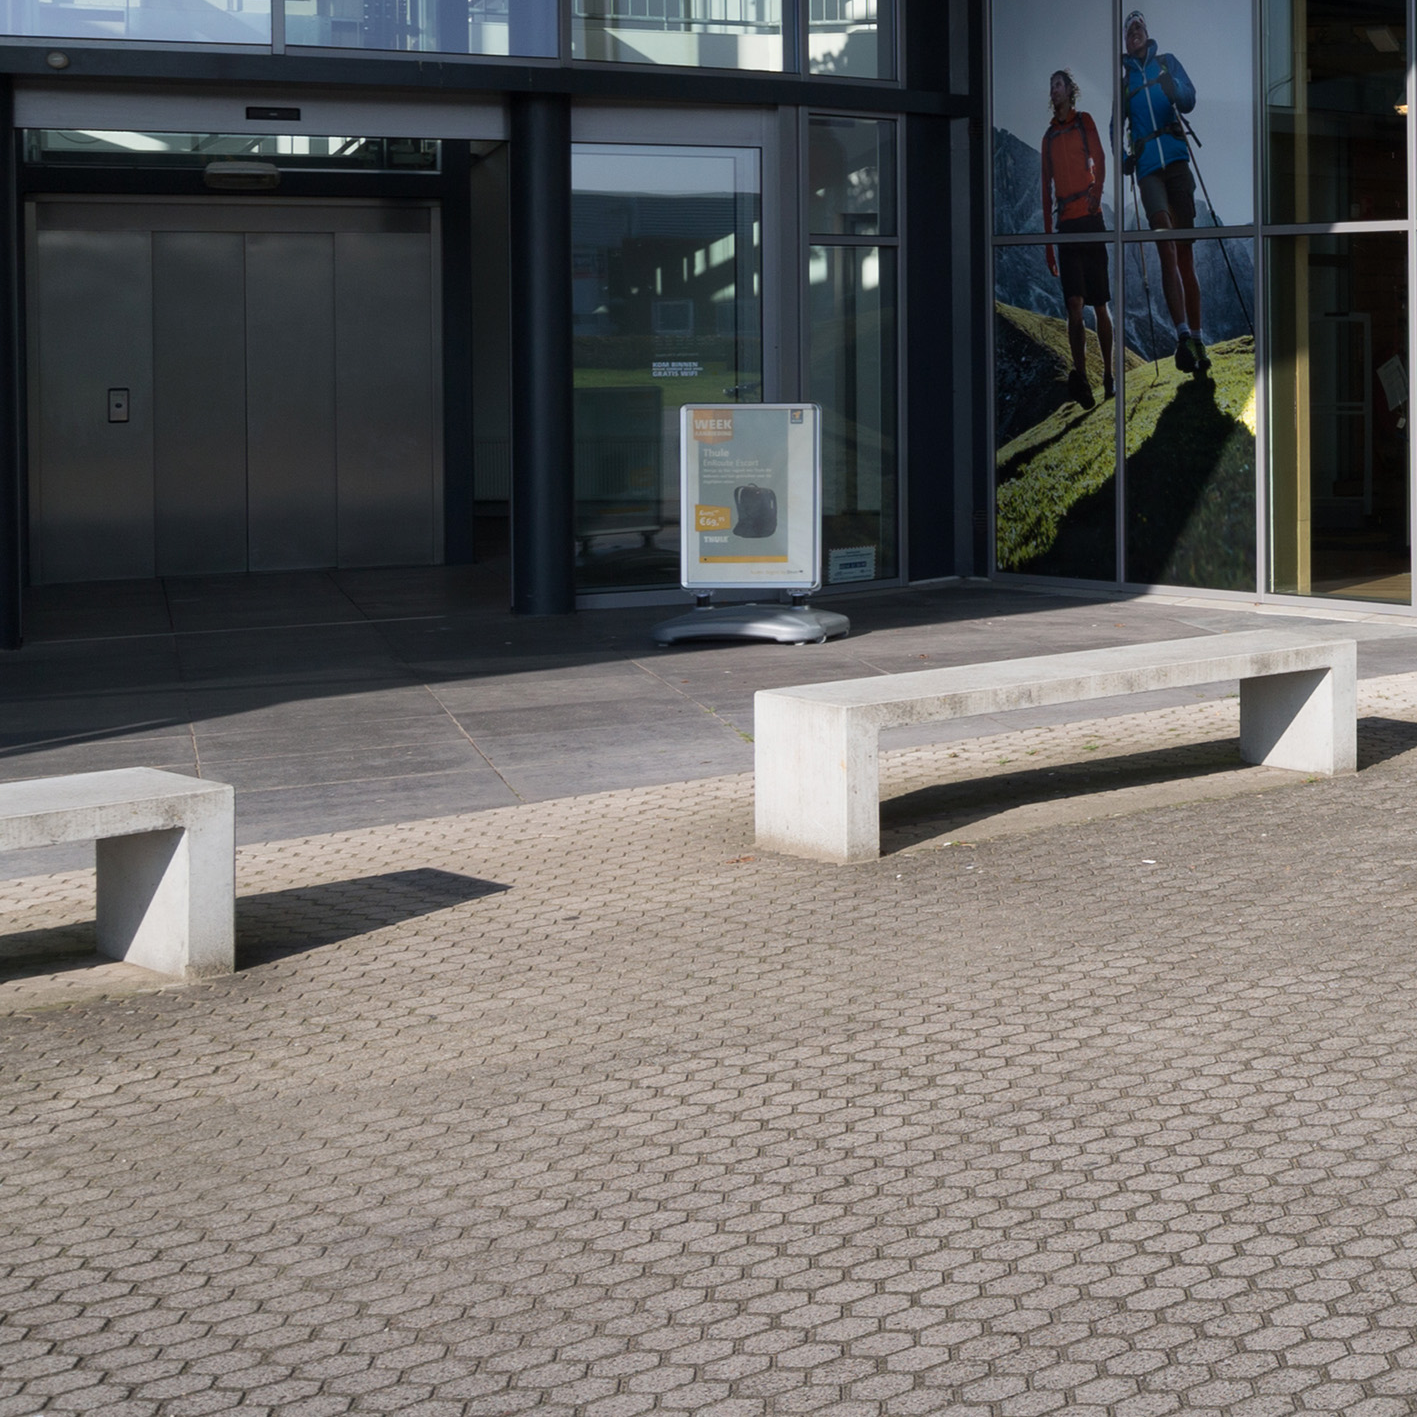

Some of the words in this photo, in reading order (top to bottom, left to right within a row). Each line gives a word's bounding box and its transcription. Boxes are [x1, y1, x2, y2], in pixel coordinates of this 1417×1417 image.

[694, 419, 732, 430] WEEK
[703, 448, 729, 457] Thule
[704, 535, 729, 543] THULE
